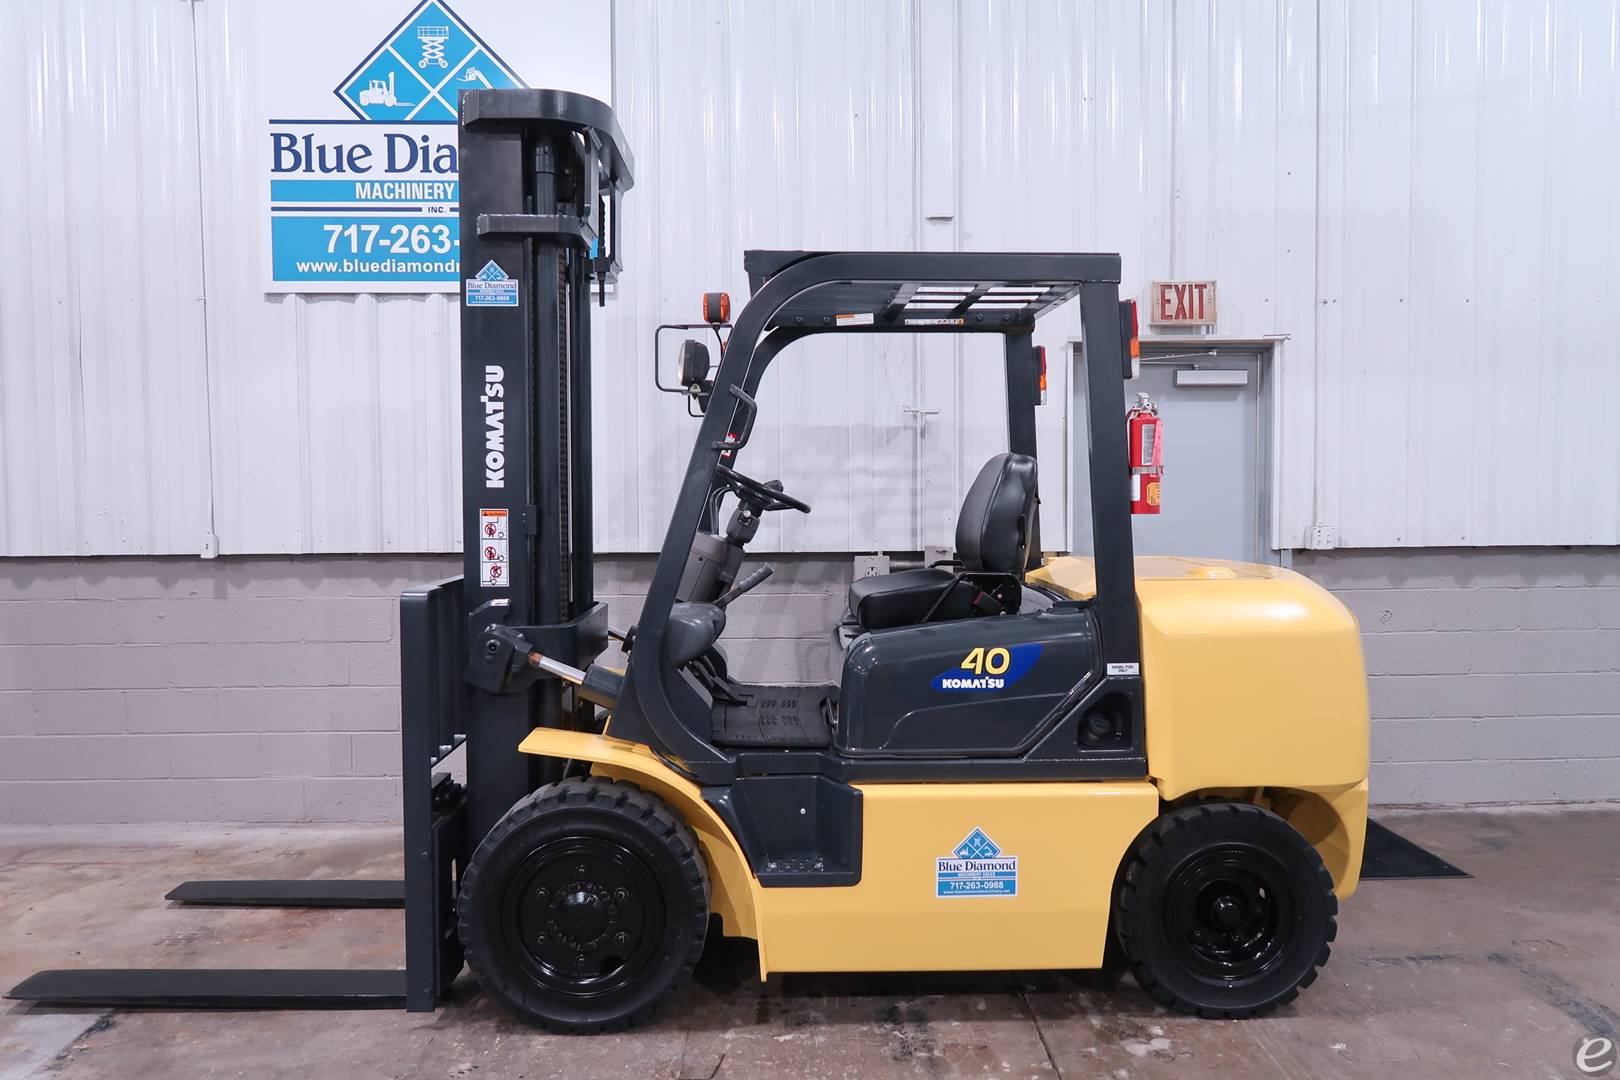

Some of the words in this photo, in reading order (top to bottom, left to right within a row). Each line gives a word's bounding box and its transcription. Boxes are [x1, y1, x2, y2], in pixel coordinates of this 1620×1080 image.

[270, 133, 373, 174] Blue
[355, 182, 455, 200] MACHINERY
[427, 206, 447, 214] INC.
[1160, 284, 1207, 320] EXIT
[480, 365, 504, 488] KOMATSU
[961, 647, 1010, 675] 40
[942, 676, 1005, 689] KOMATSU
[938, 861, 962, 871] Blue
[965, 860, 1016, 871] Diamond
[950, 881, 1004, 890] 717-263-0988
